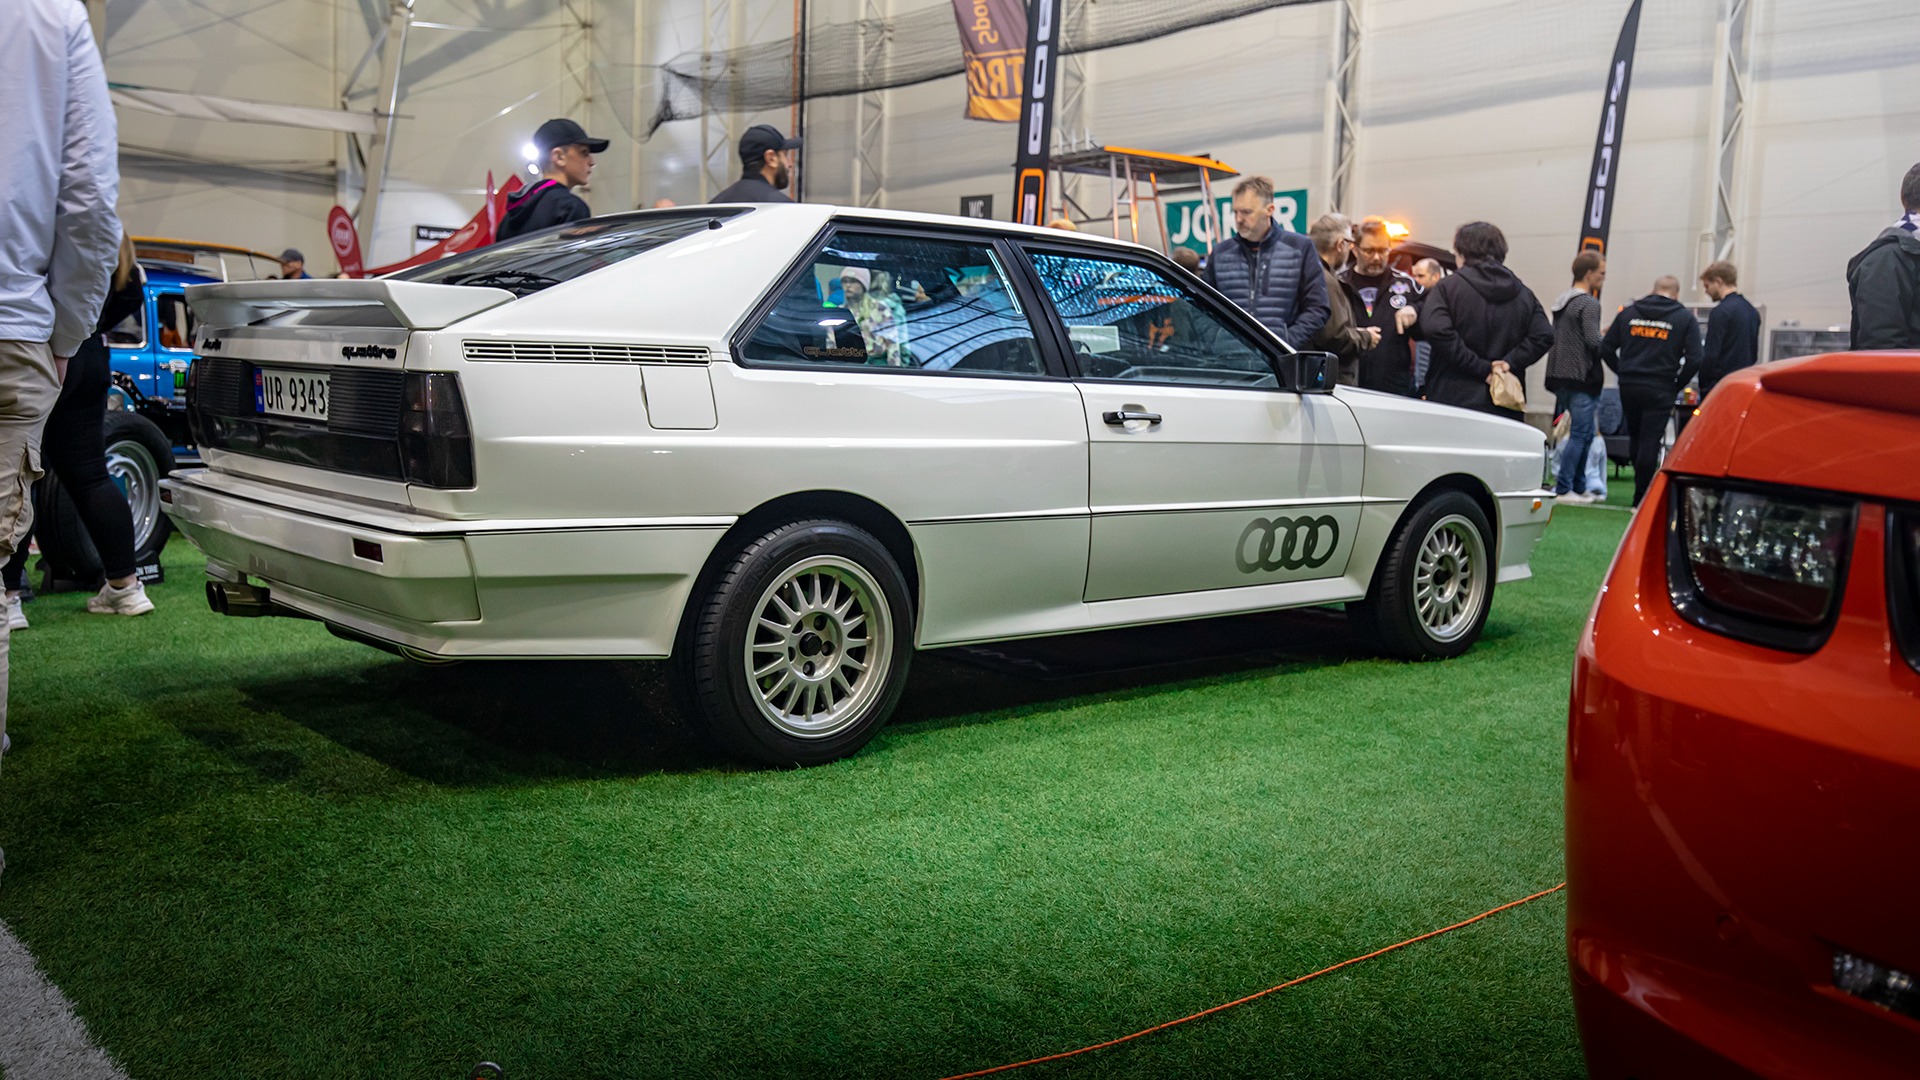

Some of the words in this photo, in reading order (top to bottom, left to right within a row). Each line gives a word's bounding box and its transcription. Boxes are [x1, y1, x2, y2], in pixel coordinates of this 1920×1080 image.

[968, 200, 985, 218] WC
[1171, 195, 1298, 245] JOKR
[341, 344, 397, 361] quattro
[264, 375, 285, 410] UR
[289, 377, 331, 416] 9343
